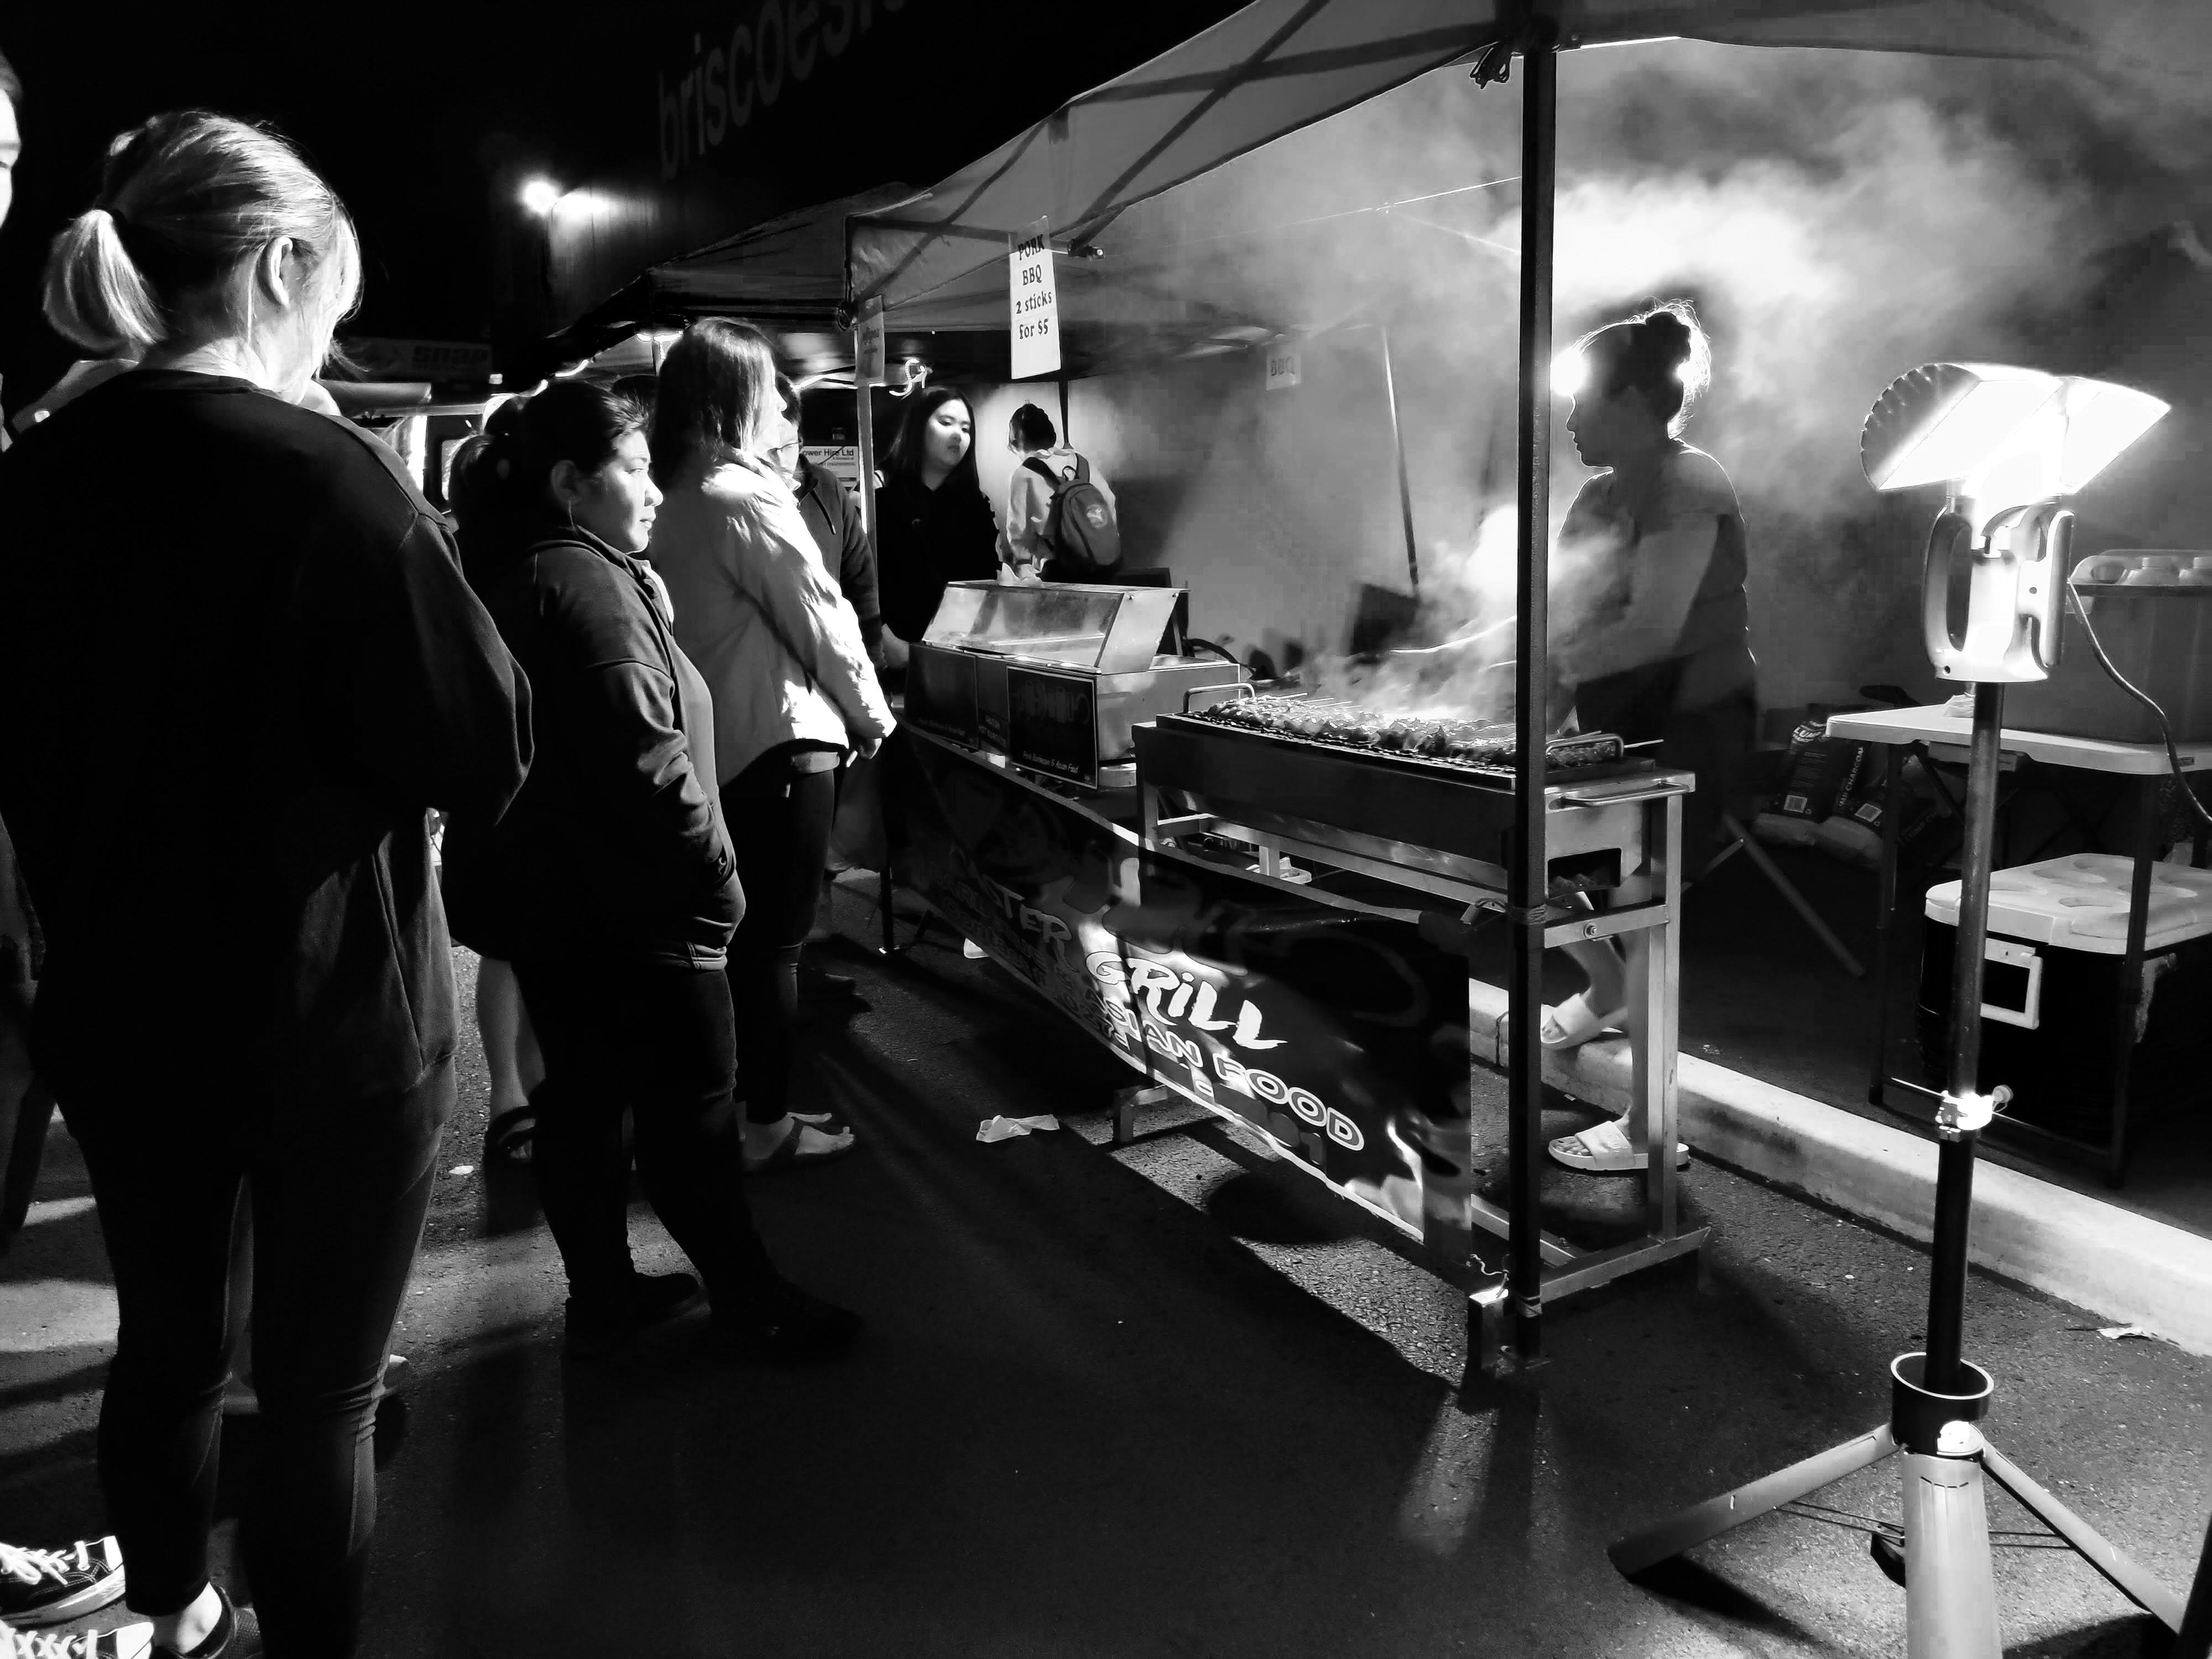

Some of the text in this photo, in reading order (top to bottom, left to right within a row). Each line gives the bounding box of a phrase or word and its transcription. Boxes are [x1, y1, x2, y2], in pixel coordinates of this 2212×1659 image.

[1018, 233, 1045, 261] PORK
[1022, 263, 1042, 286] BBQ
[1015, 290, 1052, 315] 2 sticks
[1019, 318, 1048, 340] for $5
[823, 448, 839, 456] Hire
[1213, 1052, 1365, 1151] FOOD
